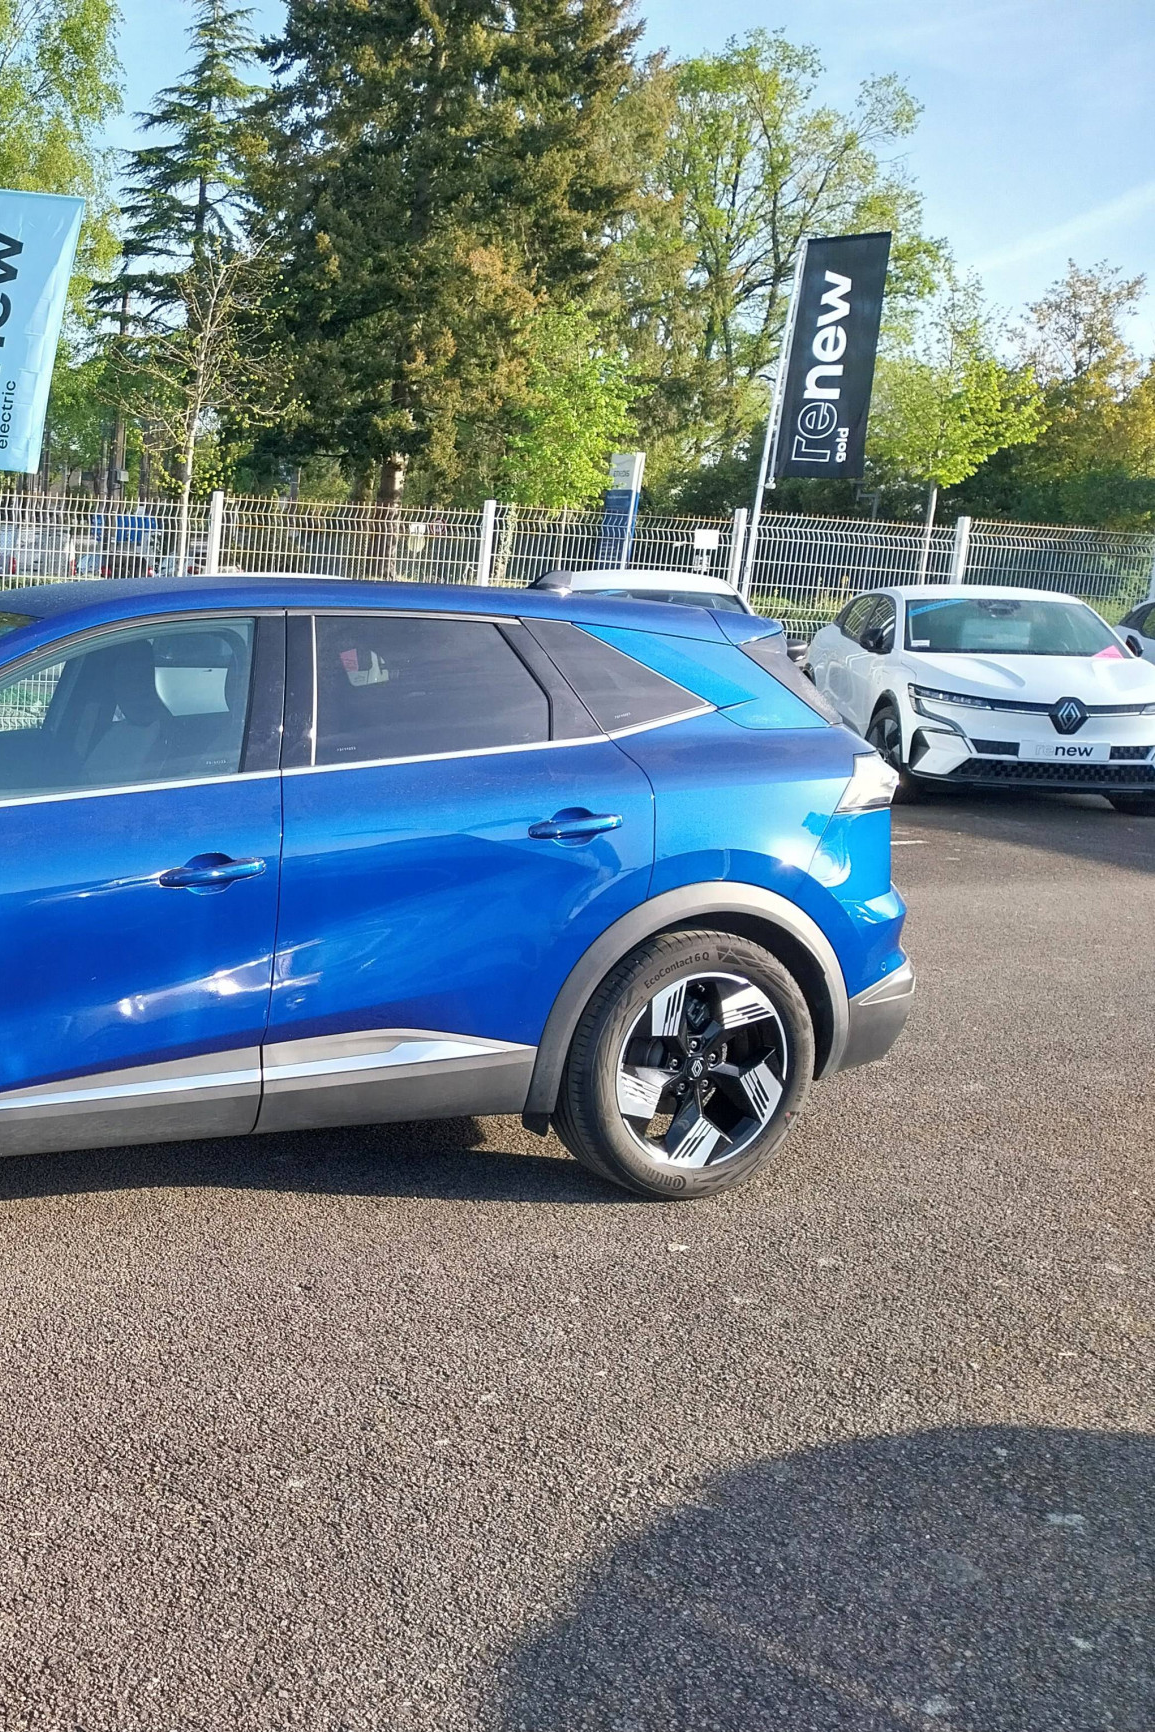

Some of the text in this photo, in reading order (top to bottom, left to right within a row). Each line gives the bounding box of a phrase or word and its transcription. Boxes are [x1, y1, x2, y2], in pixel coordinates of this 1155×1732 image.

[791, 270, 852, 463] renew
[835, 427, 849, 463] gold
[1035, 744, 1094, 757] renew
[643, 951, 710, 989] EcoContact 6 Q
